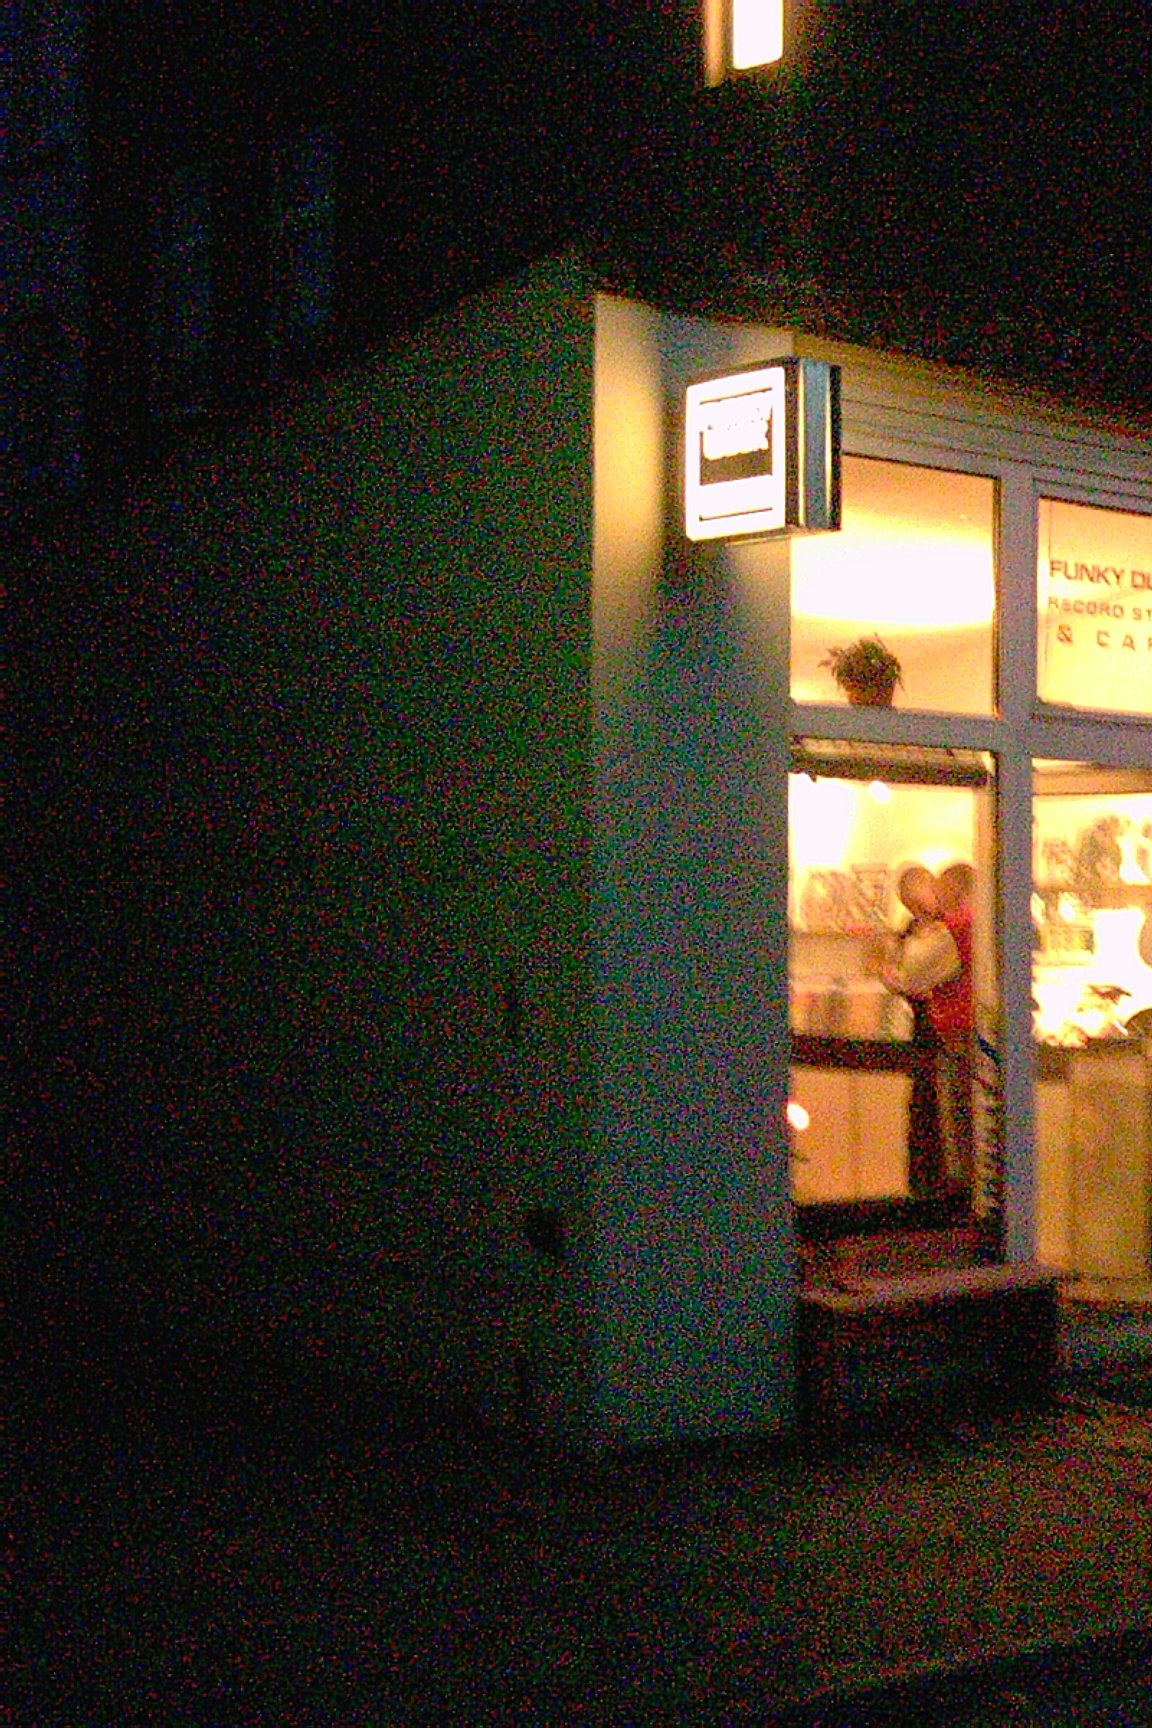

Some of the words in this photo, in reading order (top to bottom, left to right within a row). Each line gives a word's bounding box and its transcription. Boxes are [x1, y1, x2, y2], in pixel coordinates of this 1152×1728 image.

[1049, 559, 1125, 587] FUNKY
[1048, 596, 1125, 619] RECORD
[1056, 623, 1074, 644] &
